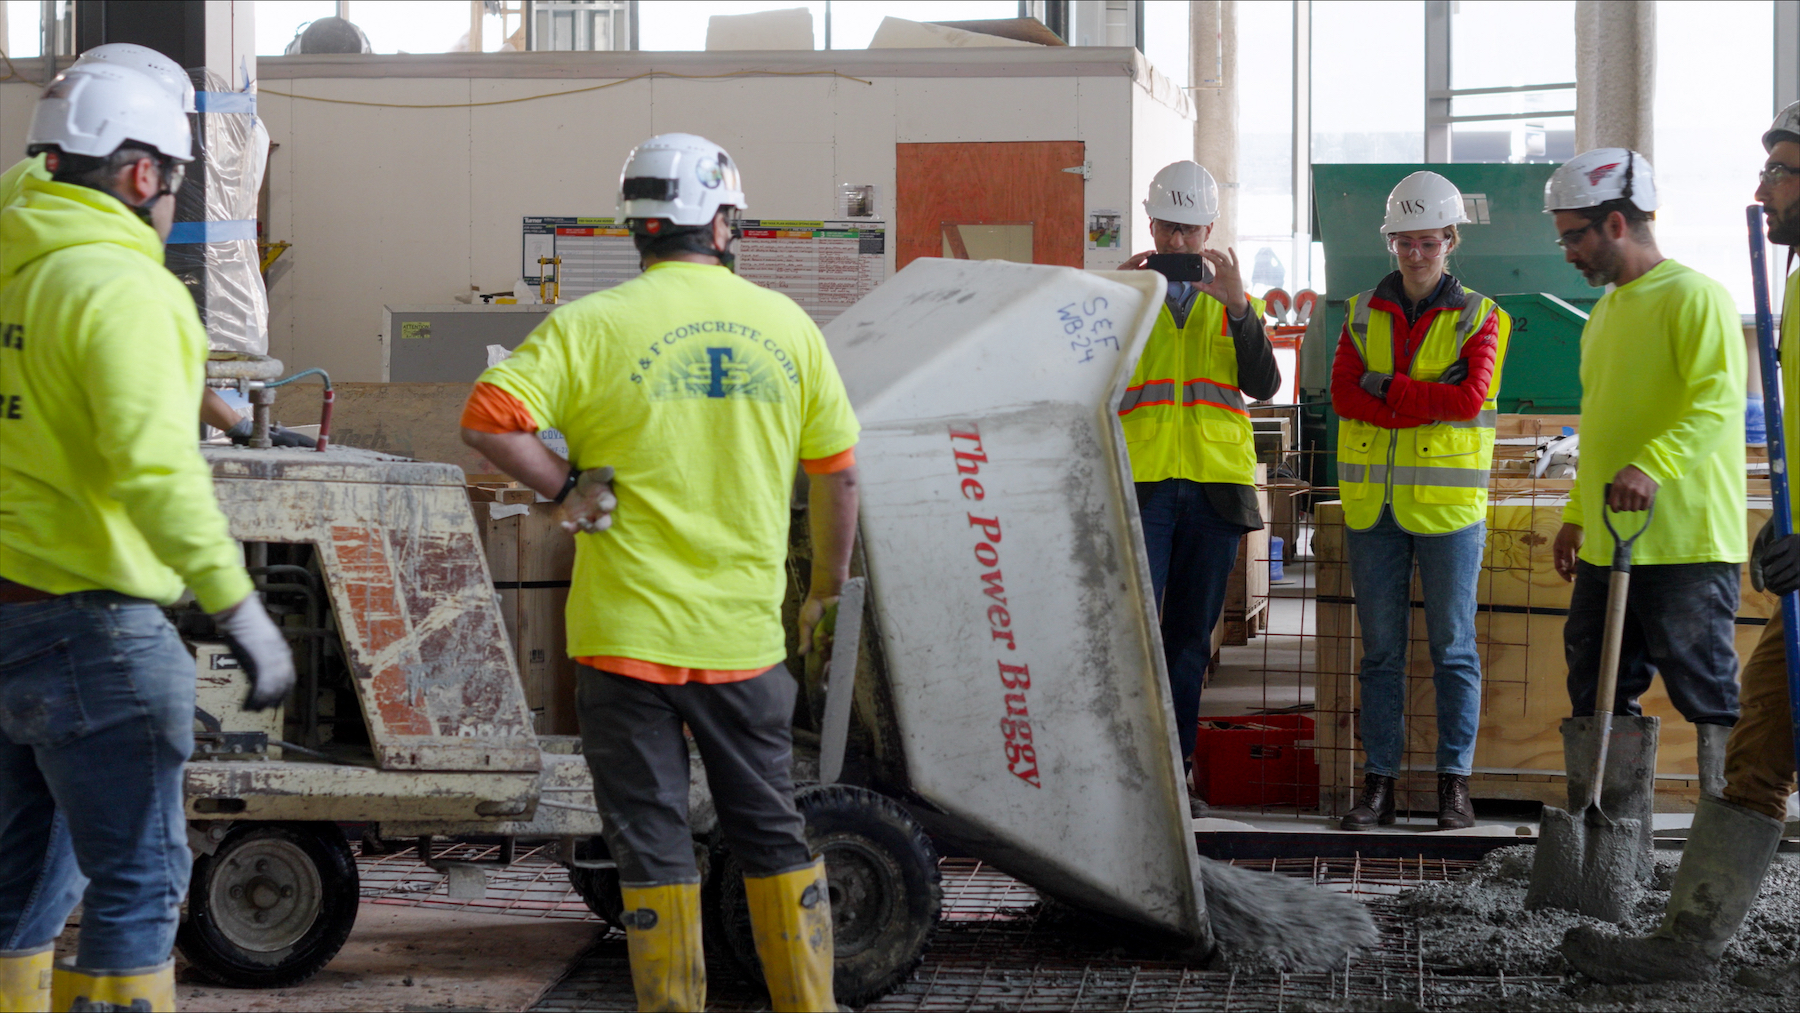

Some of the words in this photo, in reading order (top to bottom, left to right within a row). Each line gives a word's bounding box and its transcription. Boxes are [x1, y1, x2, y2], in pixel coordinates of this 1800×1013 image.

[1171, 190, 1195, 208] WS
[1400, 200, 1425, 215] WS
[631, 373, 642, 385] S
[638, 357, 653, 370] &
[649, 342, 661, 356] F
[663, 321, 762, 345] CONCRETE
[948, 422, 988, 502] The
[967, 511, 1017, 652] Power
[996, 658, 1042, 790] Buggy
